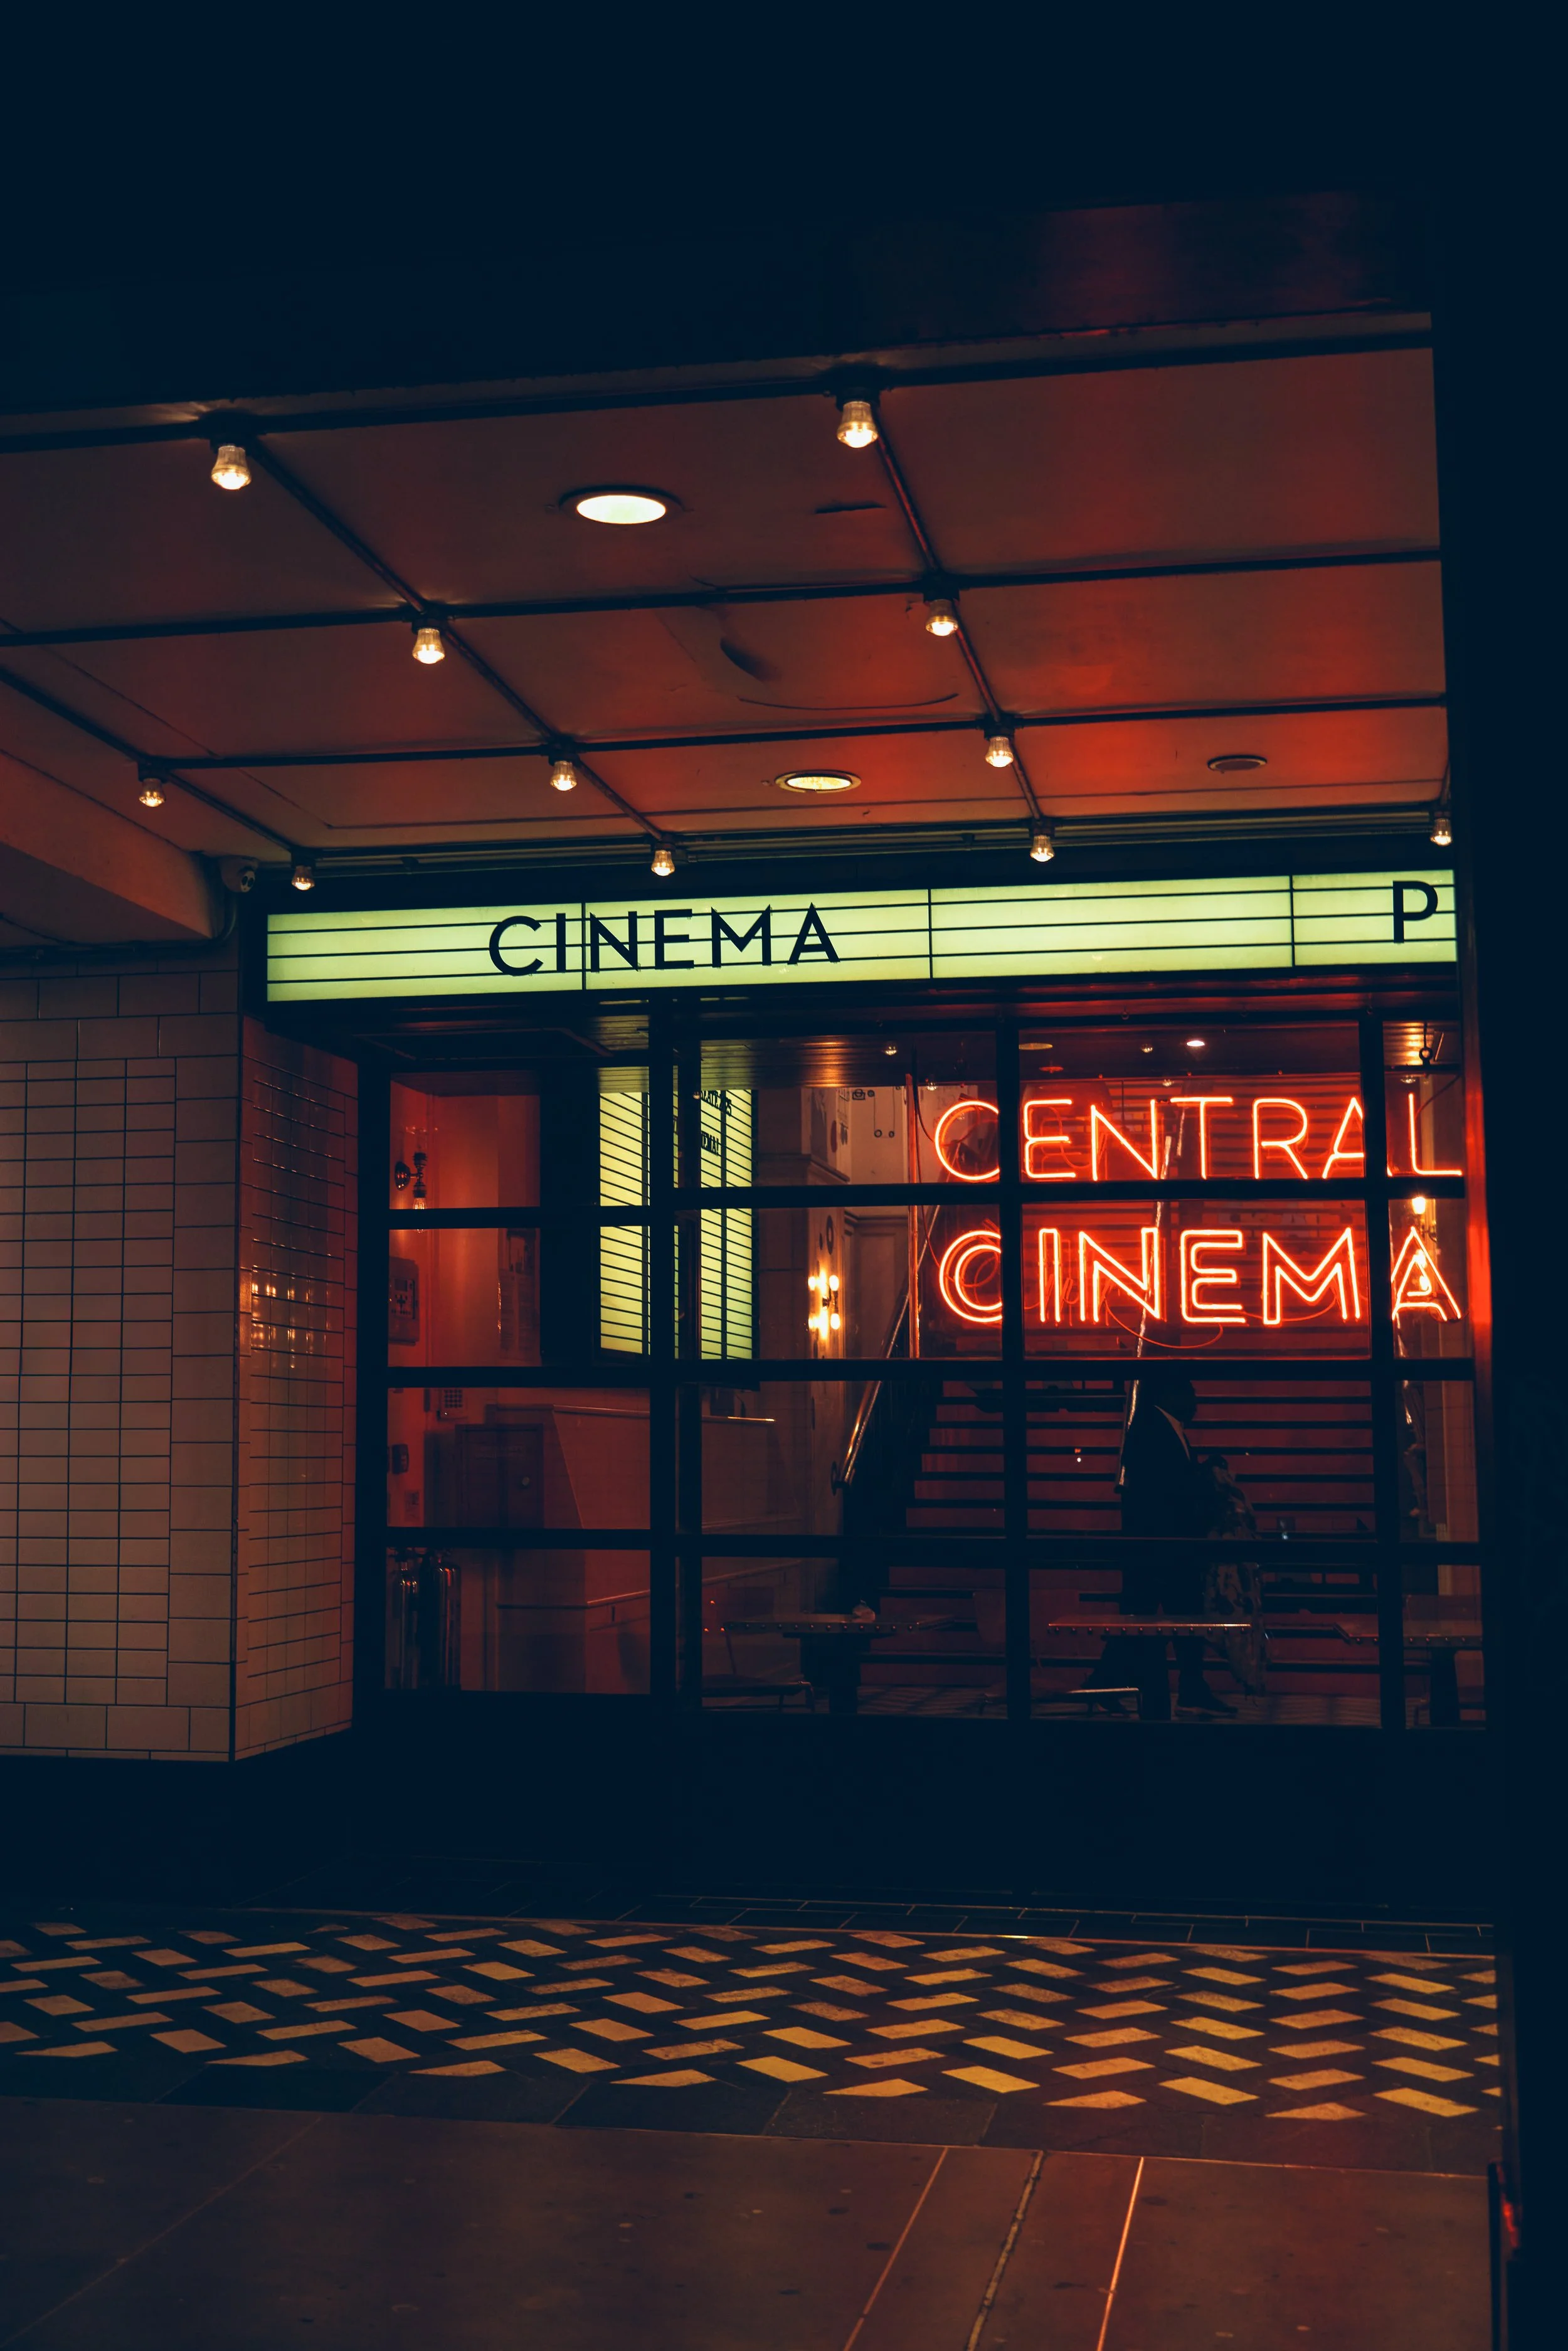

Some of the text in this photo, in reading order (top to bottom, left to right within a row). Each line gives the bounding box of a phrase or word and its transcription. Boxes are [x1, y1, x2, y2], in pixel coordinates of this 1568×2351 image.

[489, 902, 840, 976] CINEMA
[1393, 880, 1438, 943] P
[935, 1093, 1462, 1182] CENTRAL
[938, 1225, 1462, 1326] CINEMA
